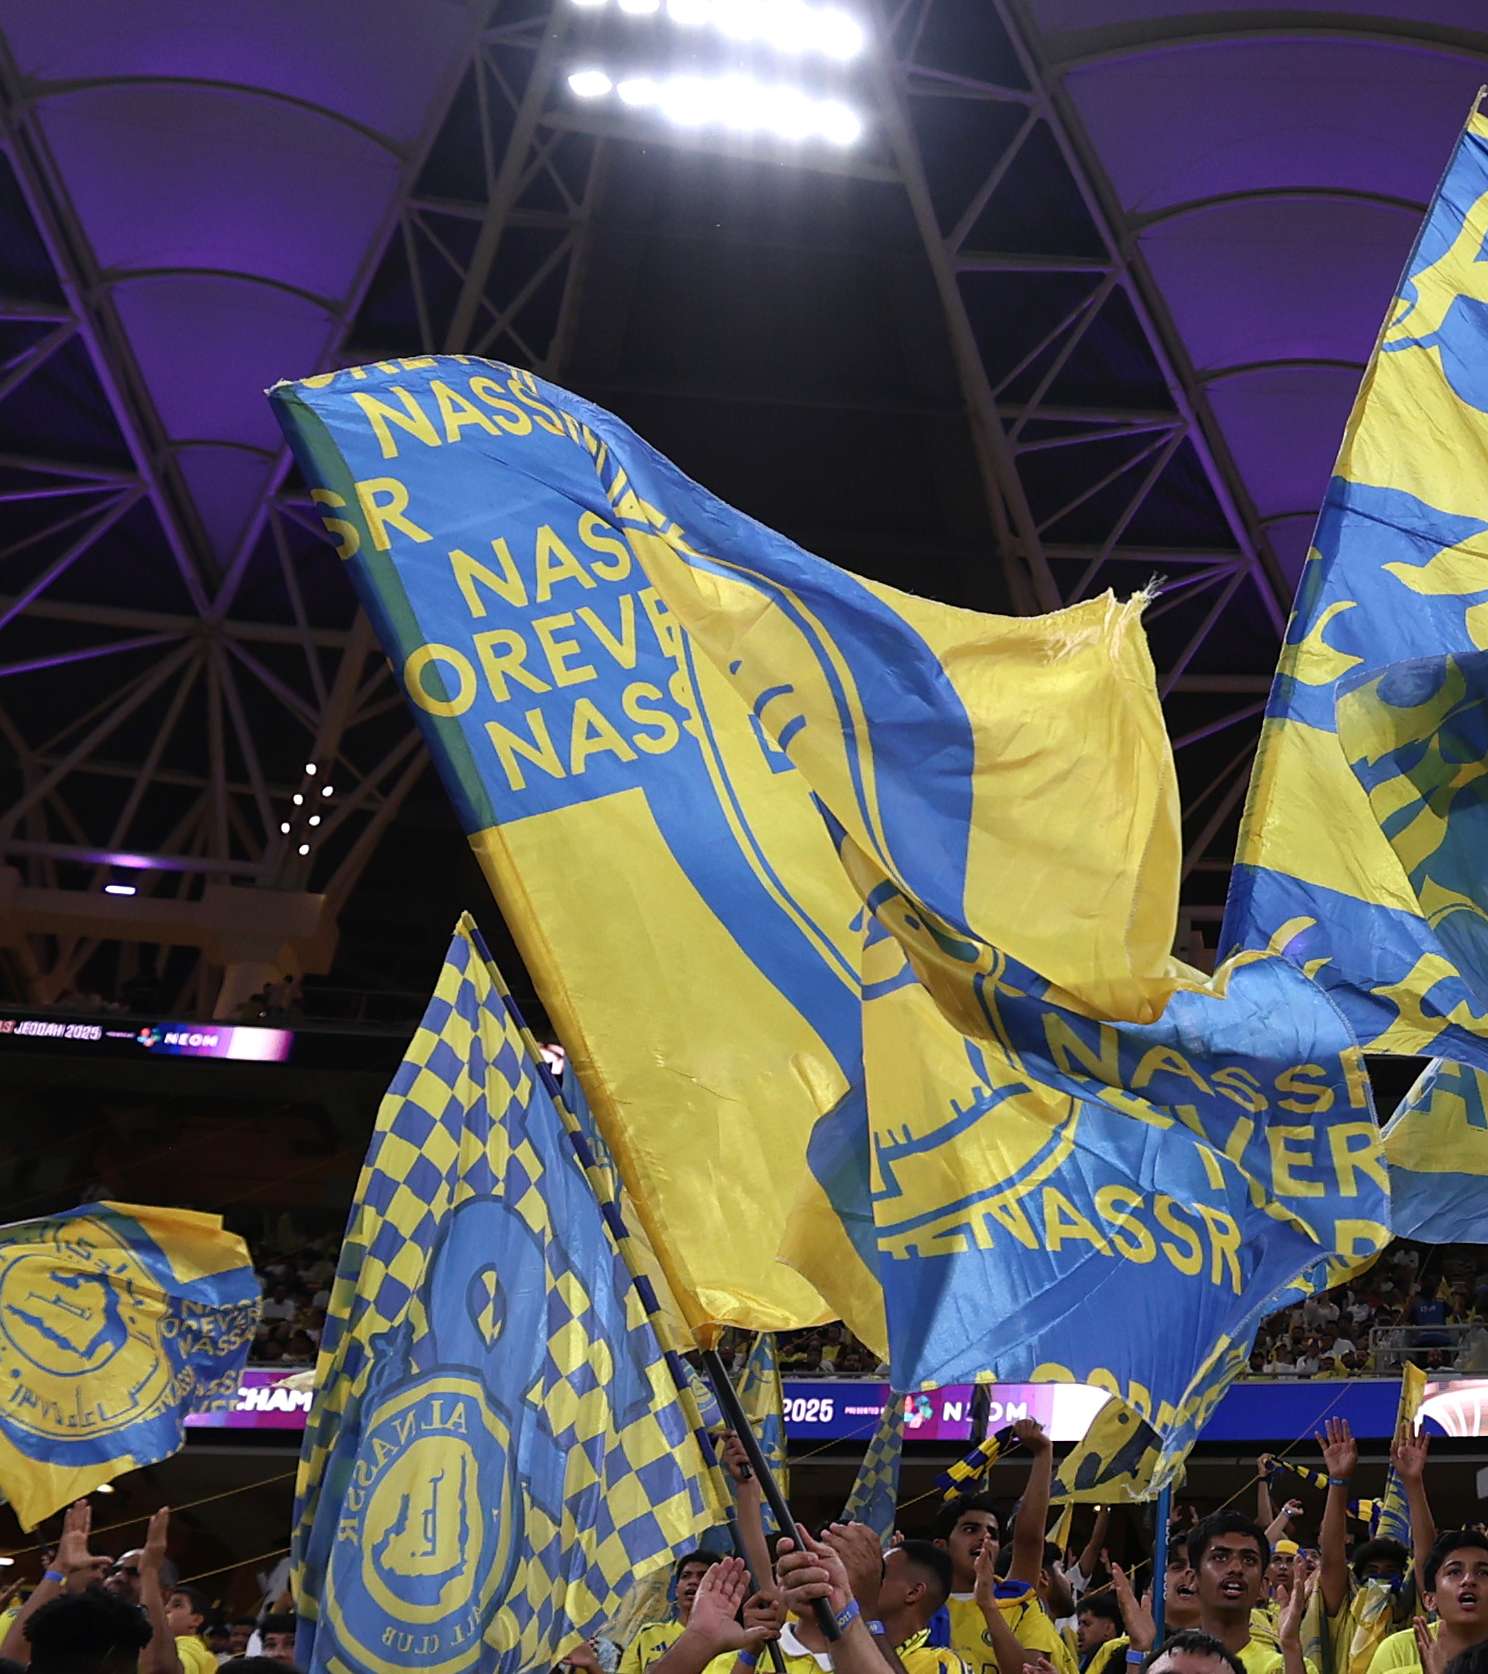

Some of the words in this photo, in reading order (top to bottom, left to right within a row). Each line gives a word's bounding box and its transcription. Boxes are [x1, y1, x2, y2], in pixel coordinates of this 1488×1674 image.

[64, 1024, 102, 1040] 2025
[968, 1182, 1243, 1296] NASSR
[783, 1398, 834, 1422] 2025
[942, 1402, 1028, 1422] NOM
